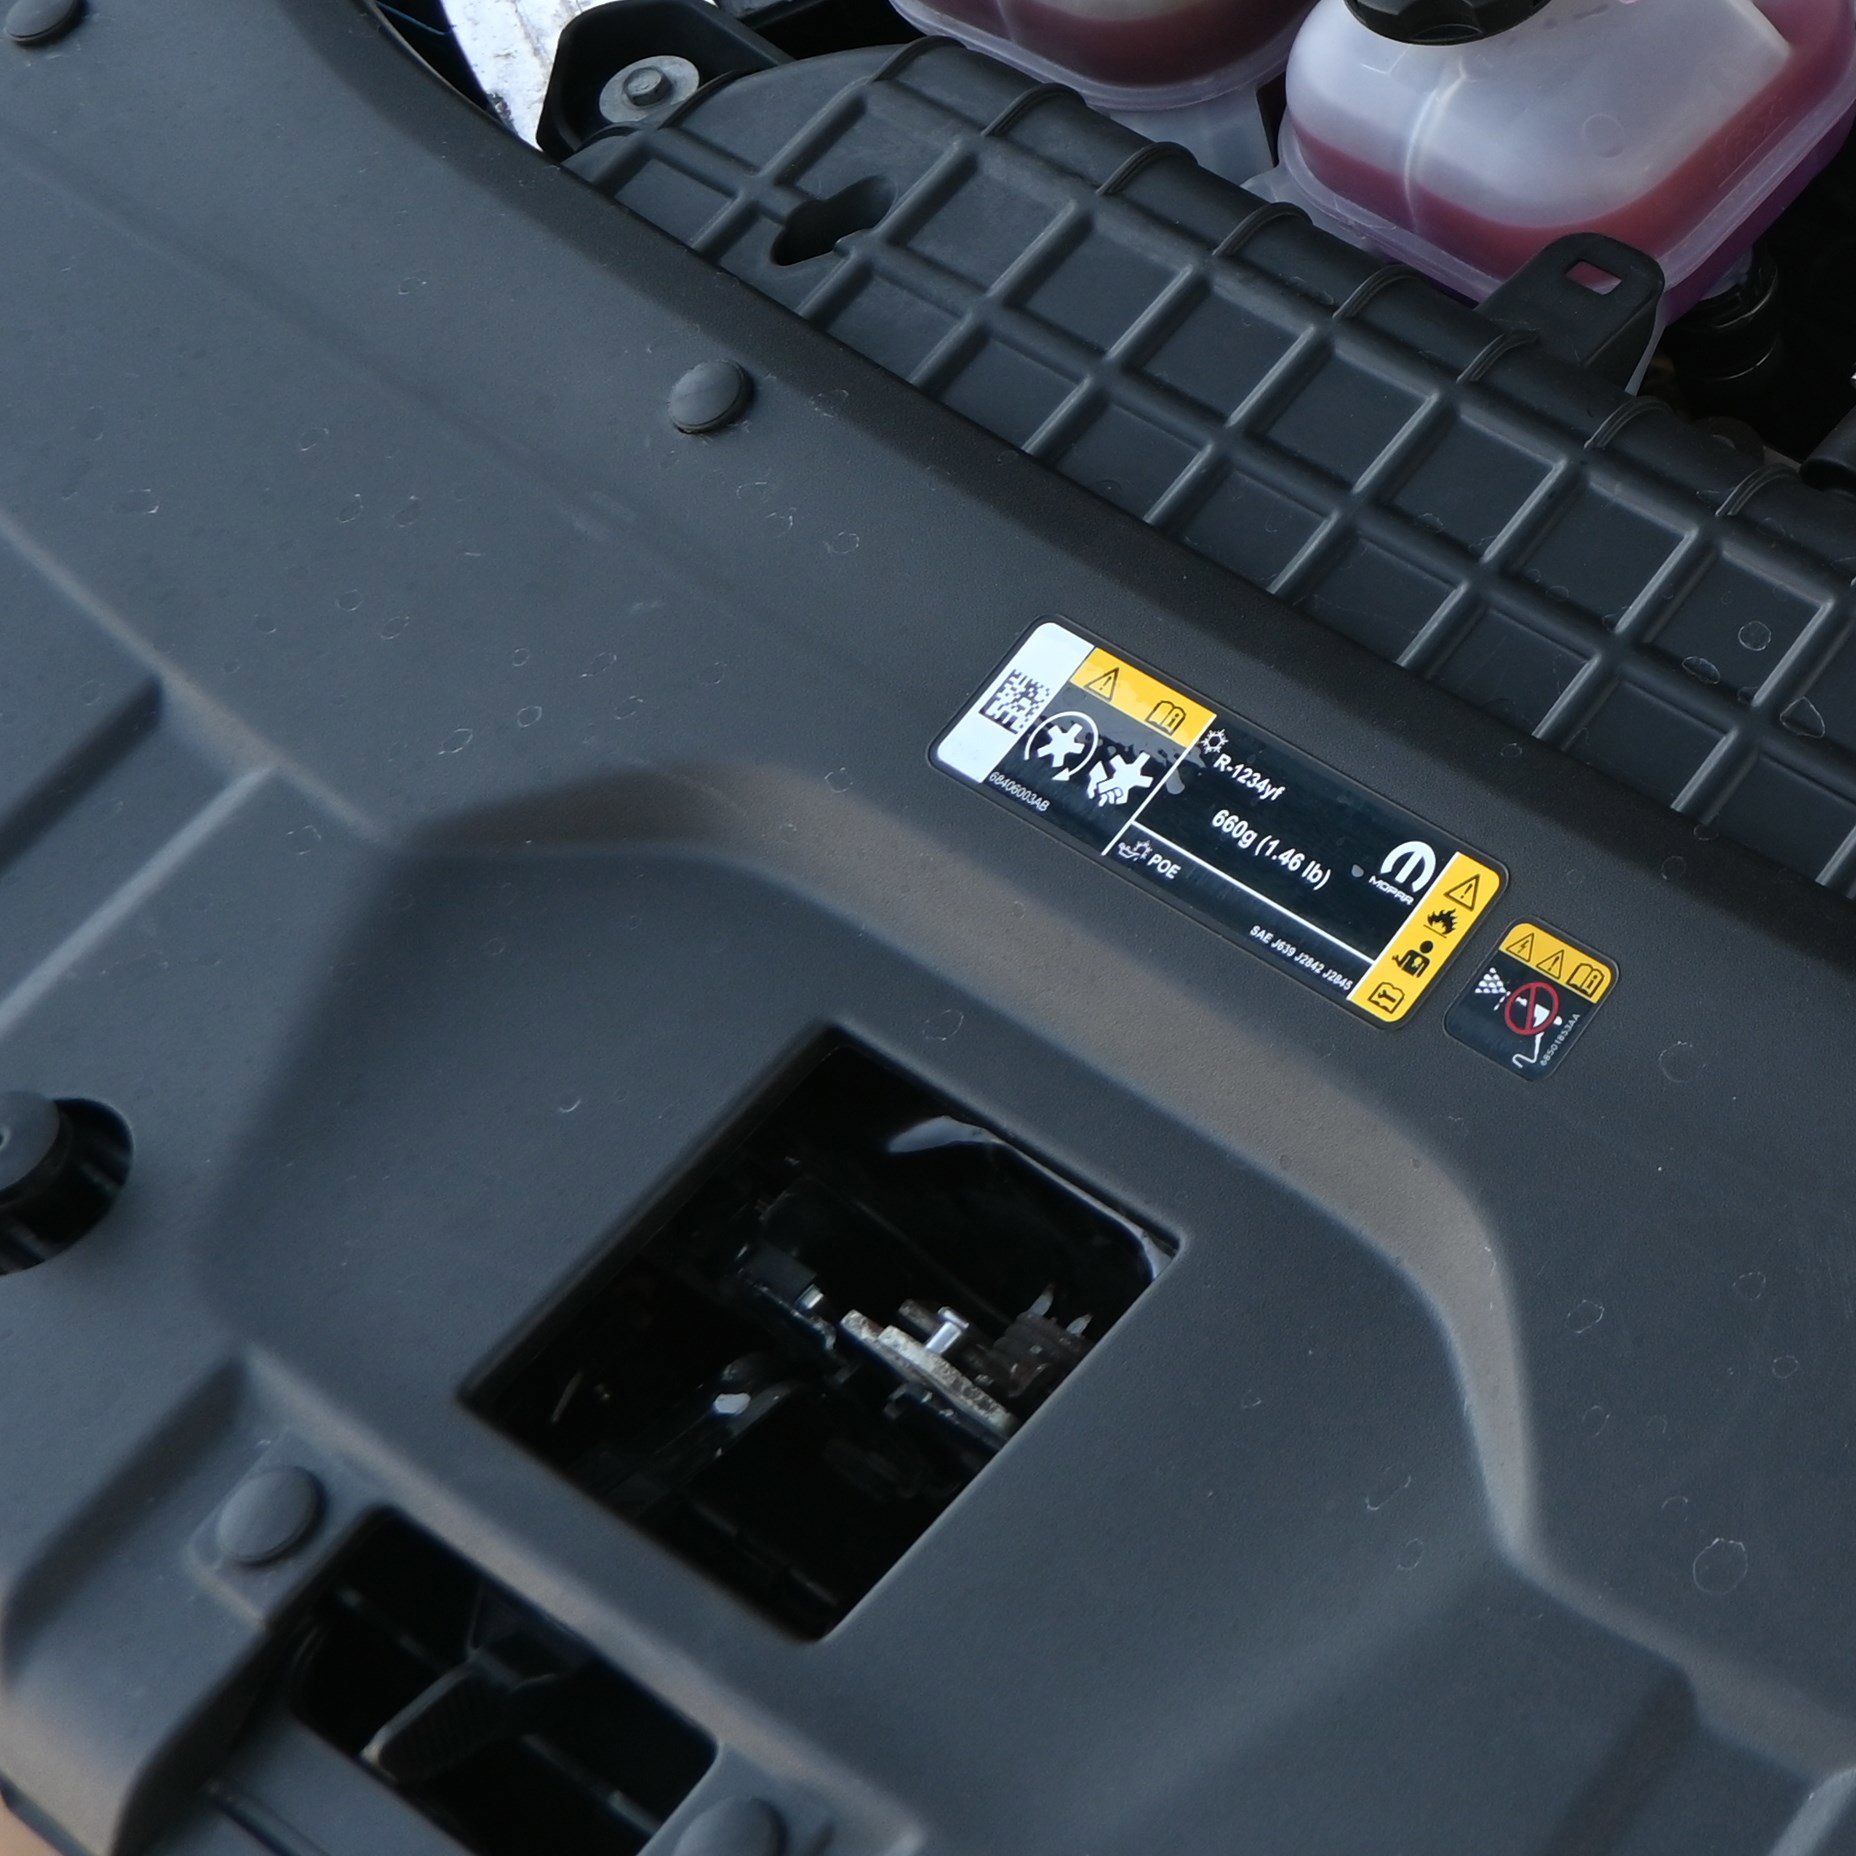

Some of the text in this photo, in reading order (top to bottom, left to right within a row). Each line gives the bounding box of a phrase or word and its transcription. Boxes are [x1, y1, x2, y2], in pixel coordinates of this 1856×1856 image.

[989, 771, 1051, 813] 68406003AB
[1213, 753, 1286, 801] R-1234yf
[1148, 853, 1182, 879] POE
[1211, 809, 1331, 891] 660g (1.46 lb)
[1368, 875, 1415, 906] MOPAR
[1250, 925, 1354, 992] SAE J639 J2842 J2845
[1540, 1013, 1581, 1067] 68501853AA
